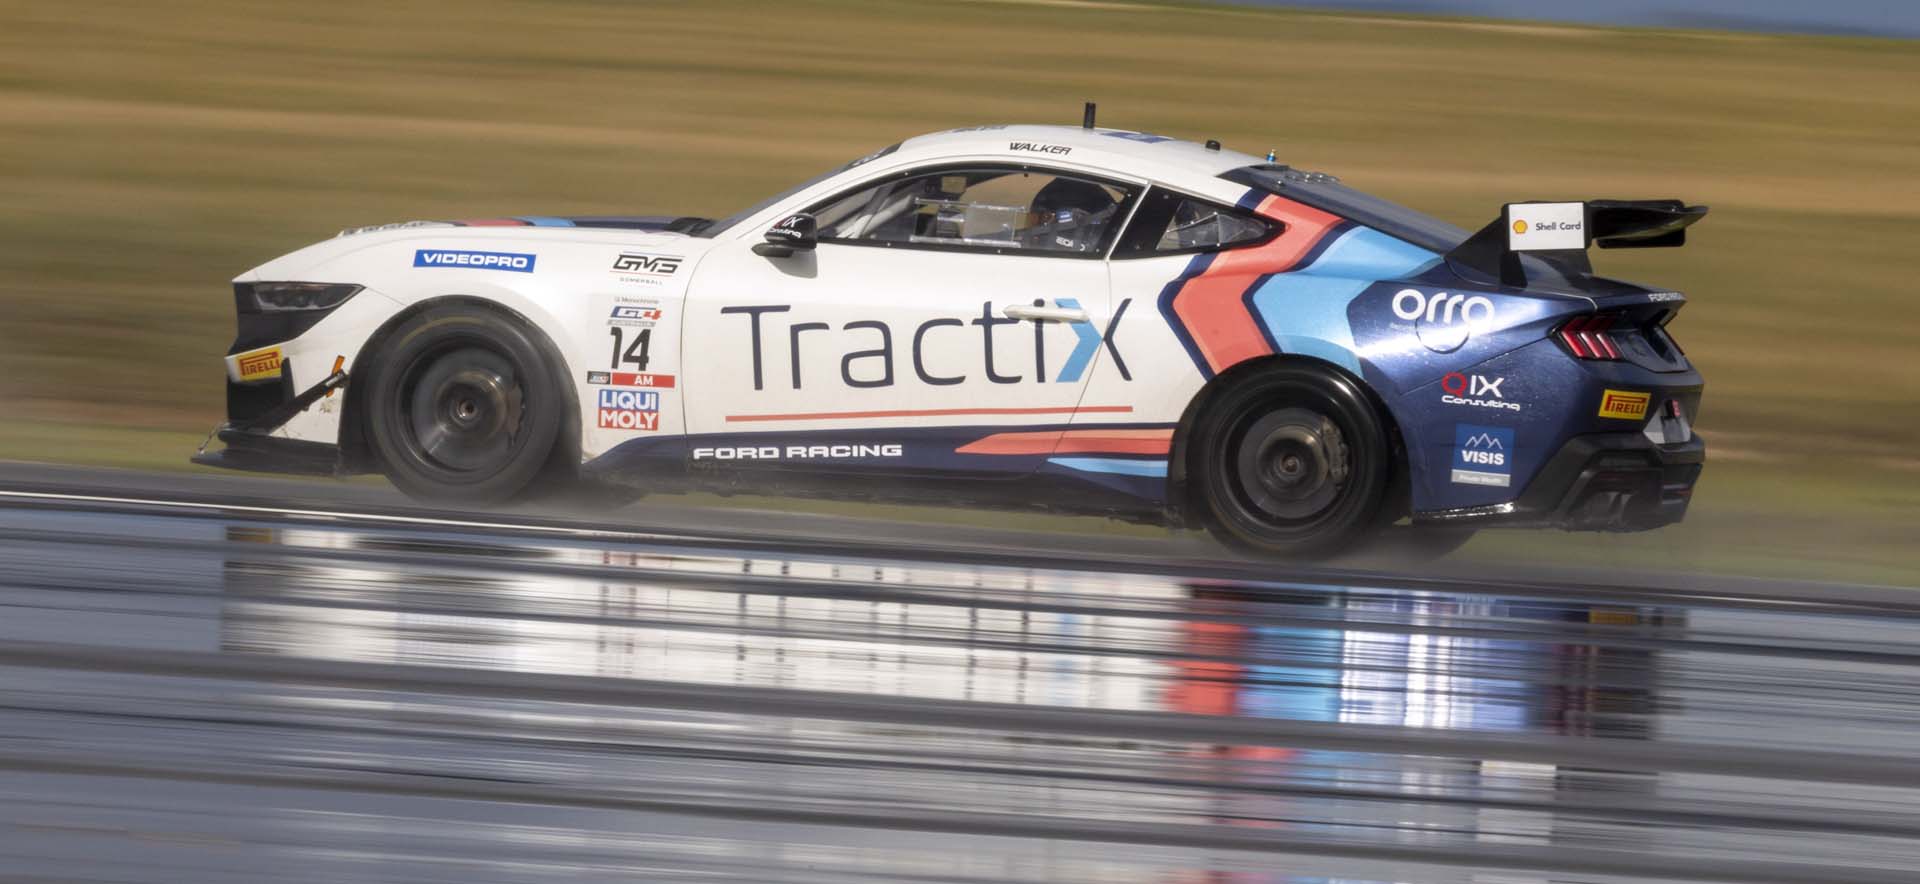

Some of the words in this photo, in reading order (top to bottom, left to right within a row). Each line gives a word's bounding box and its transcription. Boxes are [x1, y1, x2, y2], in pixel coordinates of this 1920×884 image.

[1009, 142, 1072, 156] WALKER
[1536, 222, 1557, 231] Shell
[1560, 221, 1582, 231] Card
[423, 252, 528, 269] VIDEOPRO
[612, 253, 683, 274] GMS
[1391, 288, 1496, 327] orro
[610, 326, 652, 372] 14
[240, 351, 281, 377] PIRELLI
[633, 375, 654, 386] AM
[600, 390, 658, 411] LIQUI
[1441, 394, 1521, 412] Consulting
[1604, 394, 1648, 415] PIRELLI
[600, 410, 659, 430] MOLY
[693, 446, 780, 460] FORD
[786, 443, 903, 459] RACING
[1461, 449, 1505, 466] VISIS
